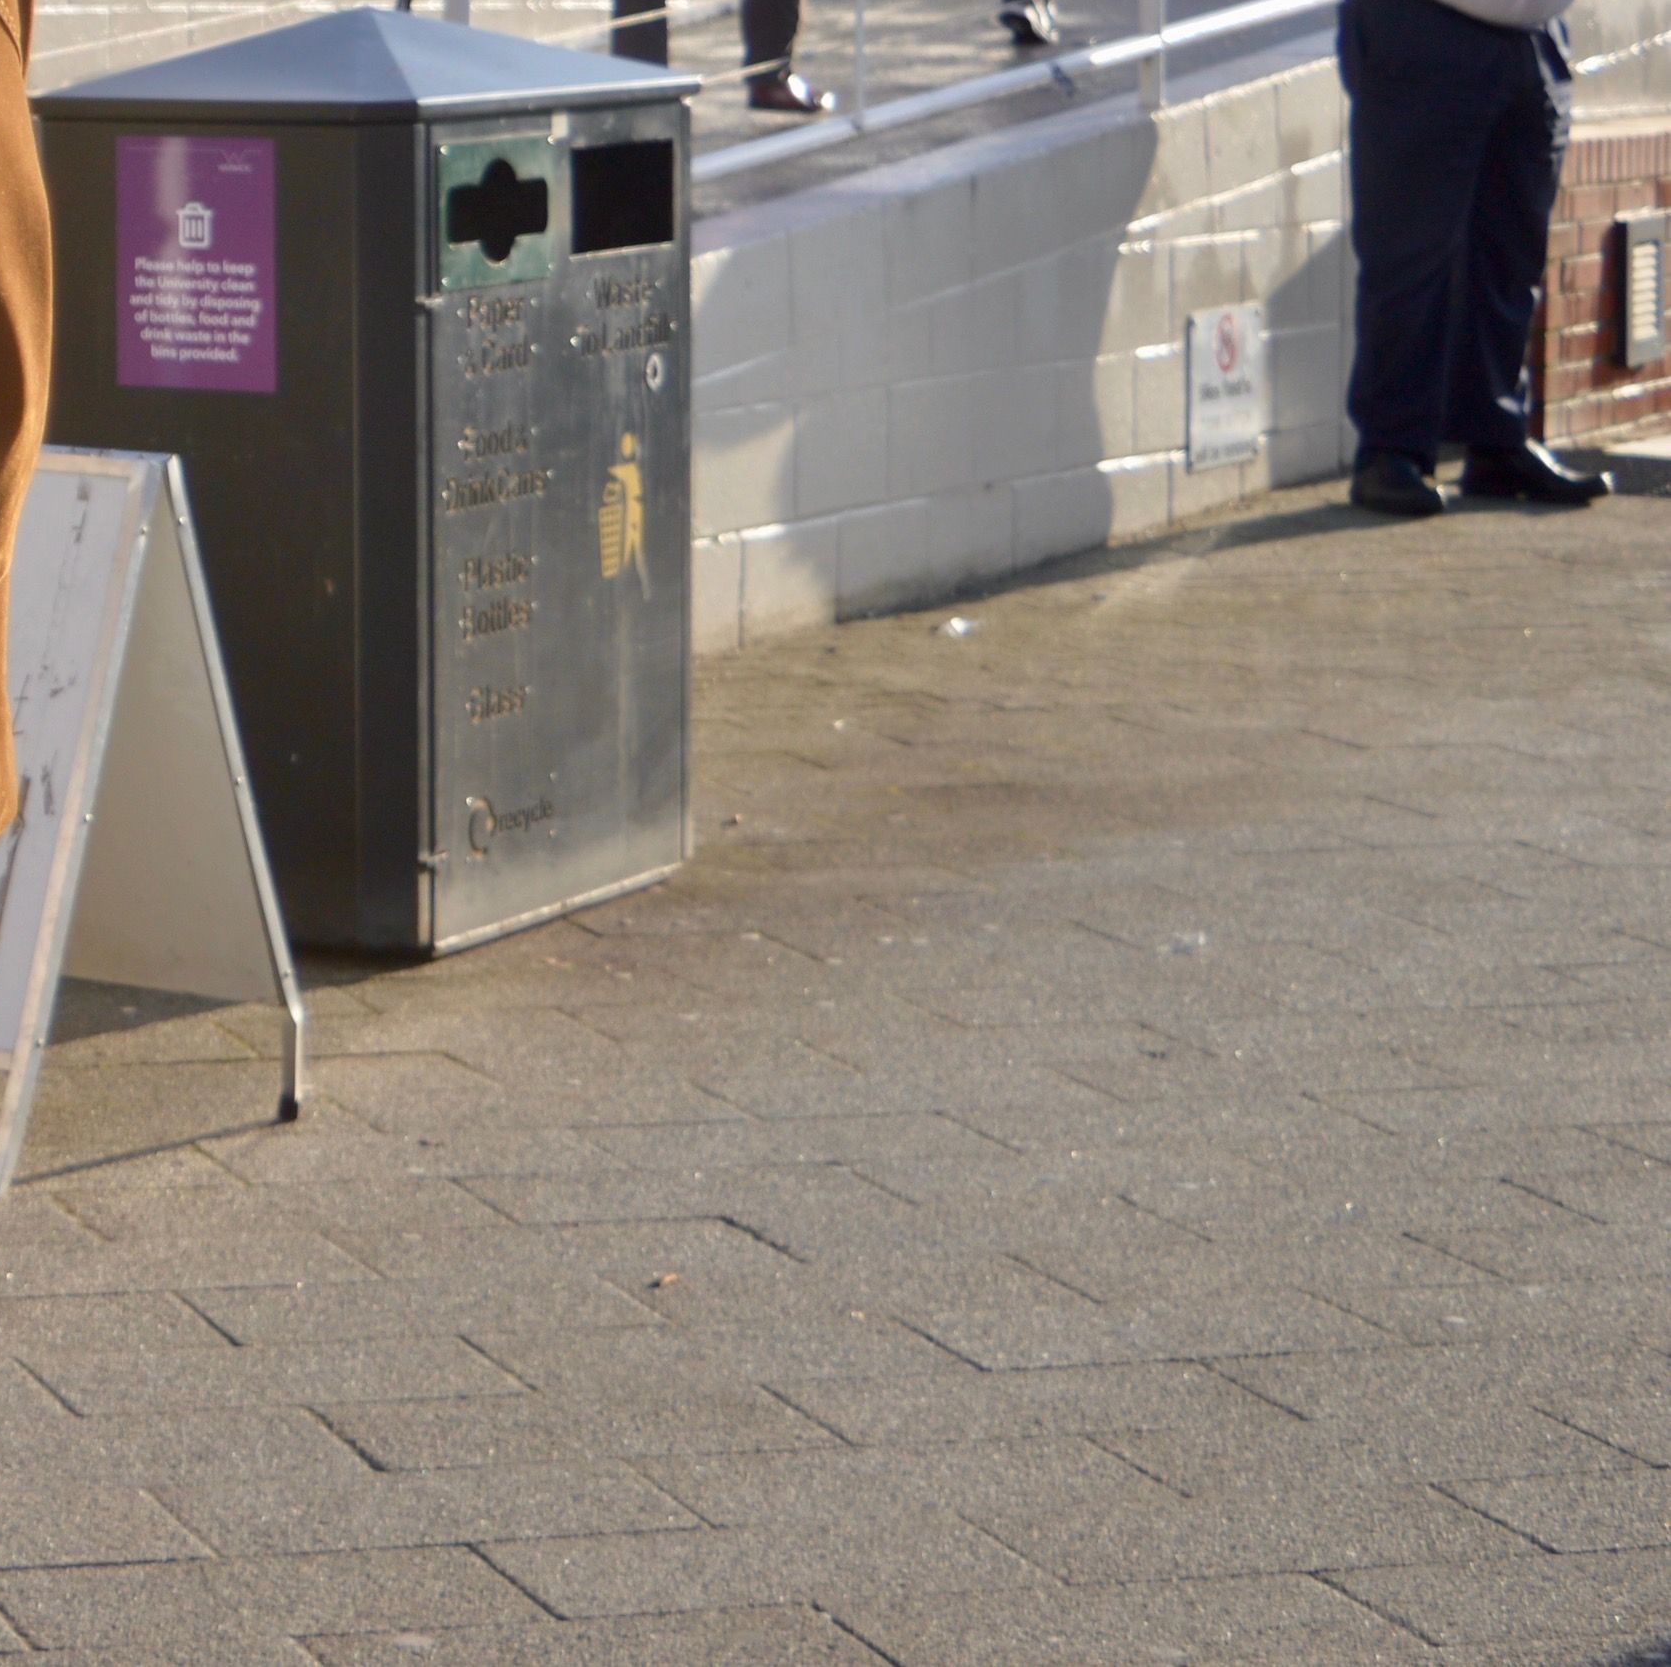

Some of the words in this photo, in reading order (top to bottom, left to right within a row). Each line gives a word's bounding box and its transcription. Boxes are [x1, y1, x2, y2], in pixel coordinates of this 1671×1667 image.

[134, 257, 174, 272] Please
[176, 258, 205, 275] help
[206, 260, 221, 274] to
[222, 260, 256, 278] keep
[134, 274, 156, 289] the
[157, 275, 220, 294] University
[220, 277, 255, 292] clean
[592, 272, 655, 311] Waste
[129, 291, 153, 306] and
[155, 292, 181, 310] tidy
[182, 293, 198, 311] by
[199, 294, 262, 313] disposing
[134, 309, 149, 324] of
[199, 312, 229, 327] food
[230, 313, 256, 328] and
[467, 295, 525, 333] Paper
[140, 327, 174, 341] drink
[175, 330, 212, 343] waste
[213, 329, 227, 344] in
[227, 330, 251, 345] the
[150, 344, 178, 360] bins
[481, 333, 529, 377] Card
[468, 685, 525, 726] Glass
[497, 794, 555, 833] recycle
